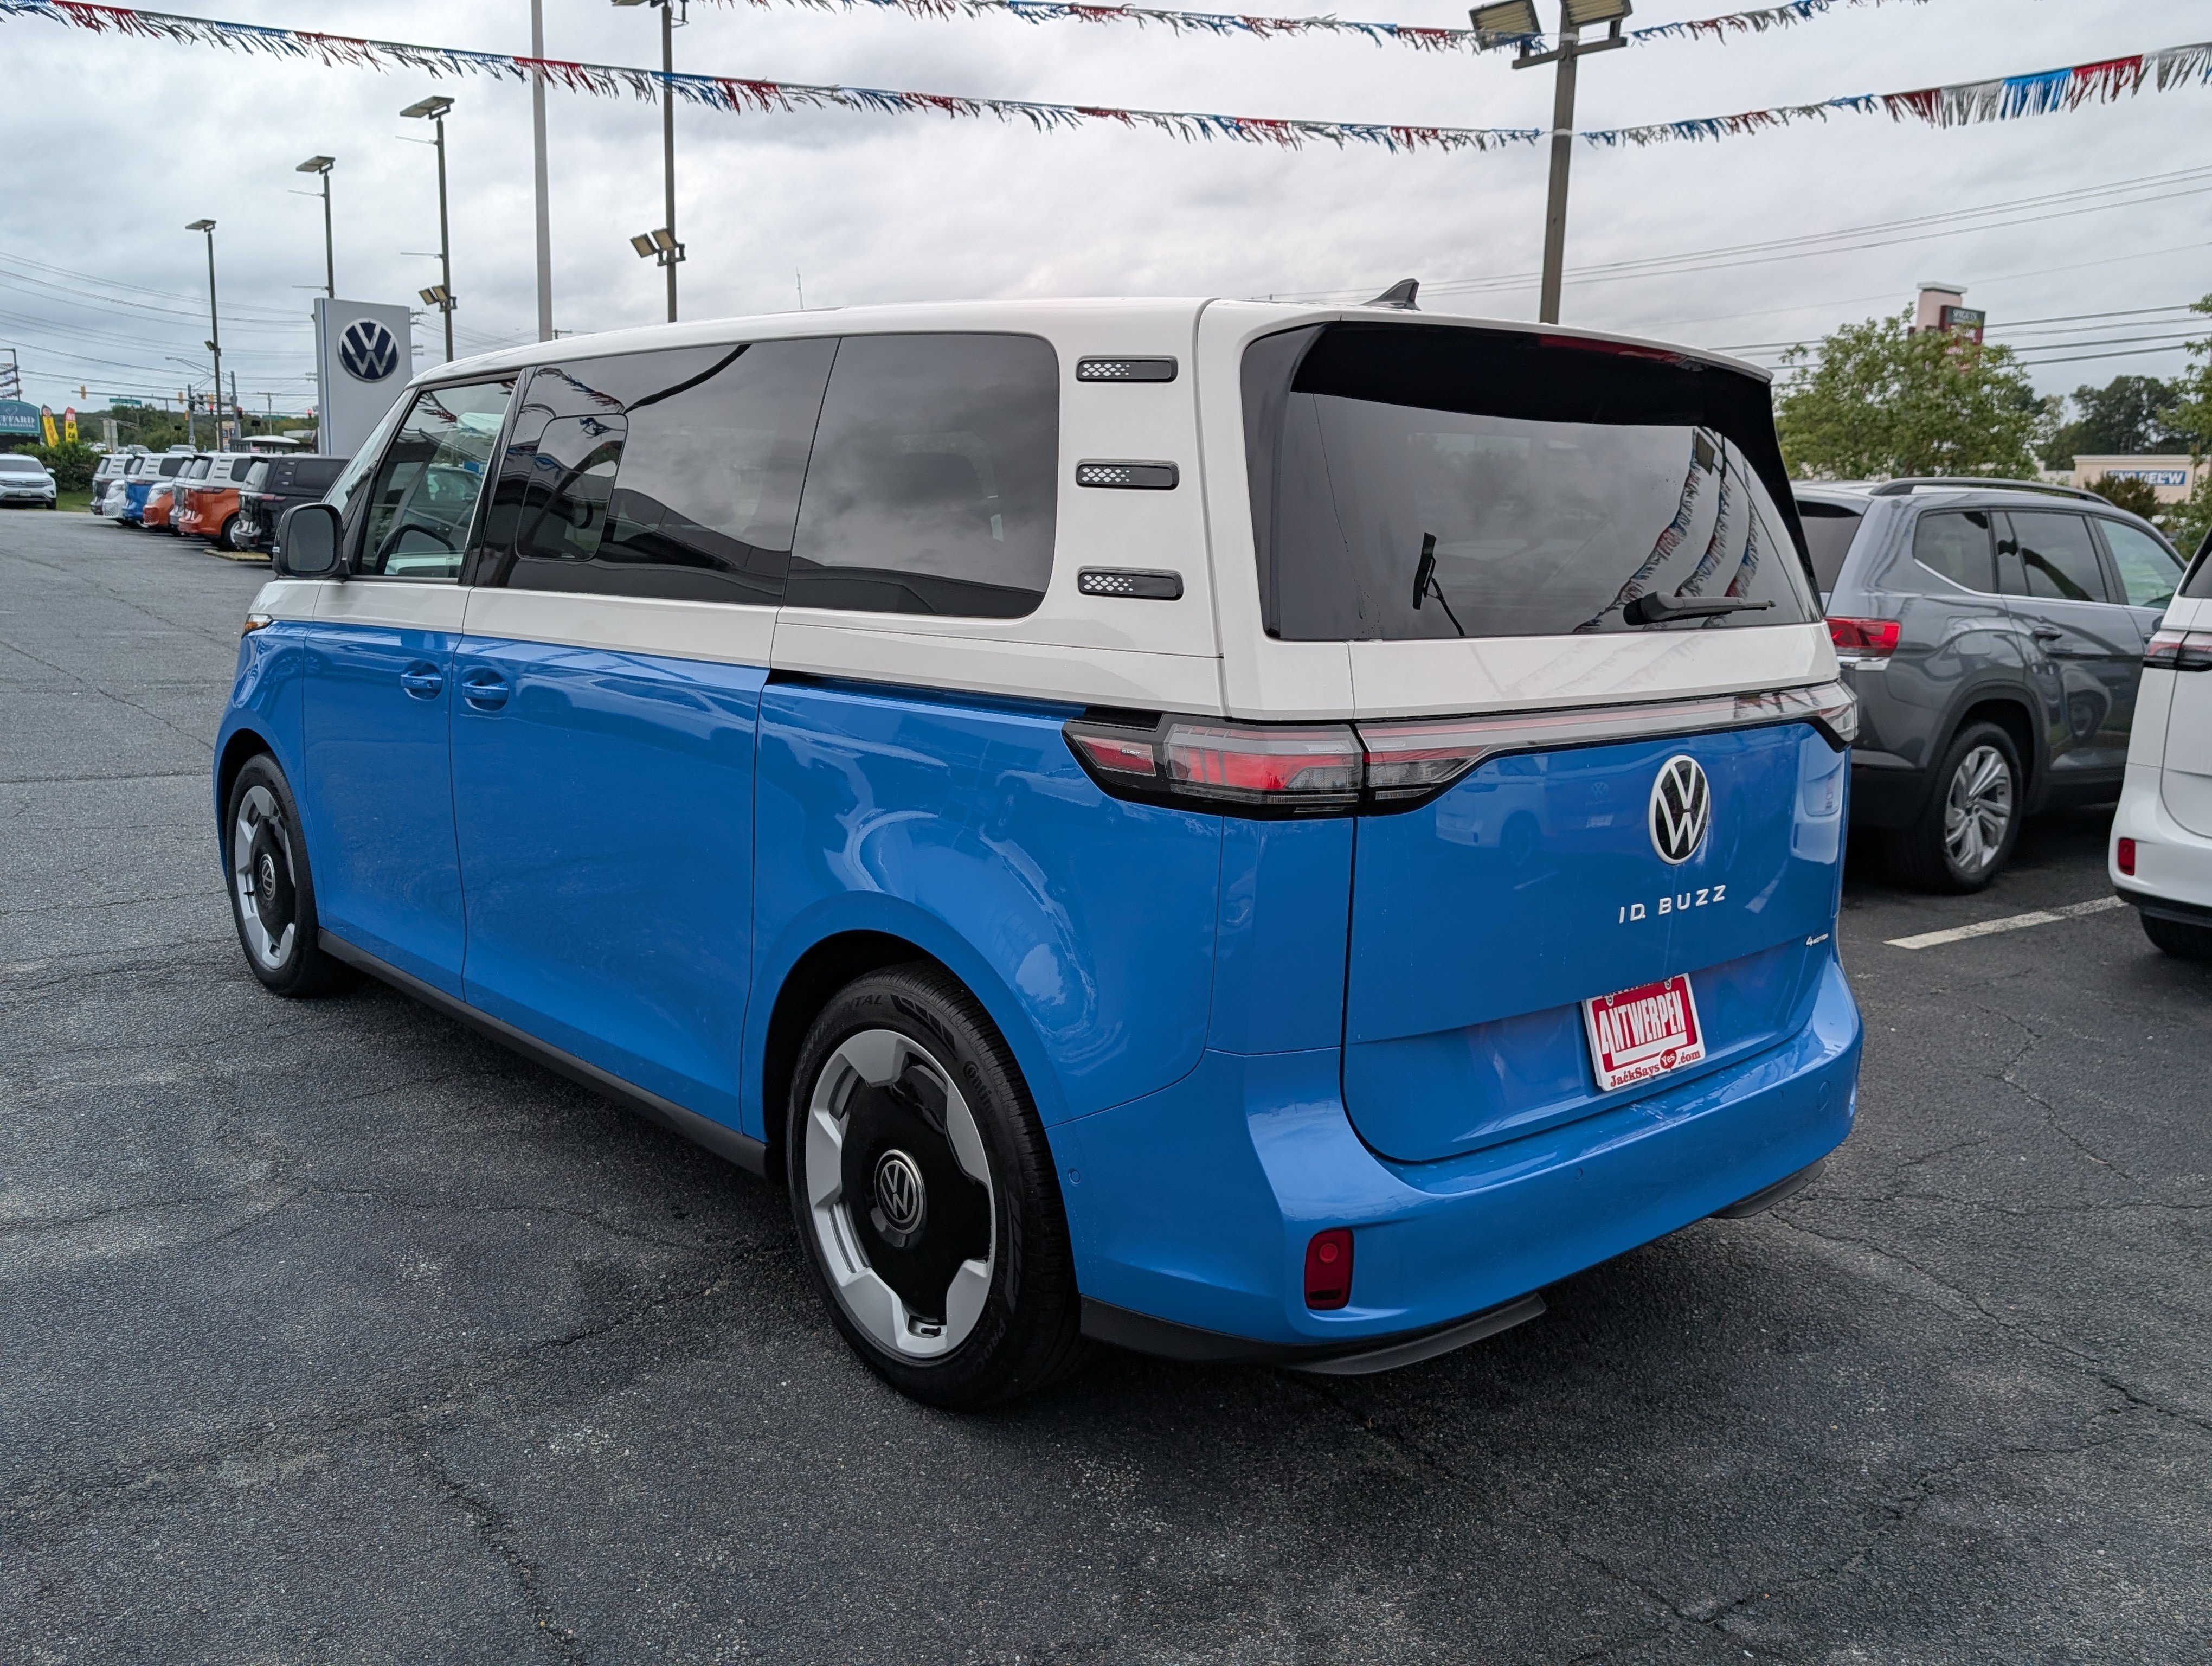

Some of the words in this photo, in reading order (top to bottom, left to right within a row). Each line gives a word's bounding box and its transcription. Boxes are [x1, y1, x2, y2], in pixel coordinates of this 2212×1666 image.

[1658, 885, 1726, 915] BUZZ
[1599, 990, 1687, 1055] ANTWERPEN
[1610, 1063, 1660, 1087] JackSays
[1661, 1053, 1675, 1066] Yes
[1678, 1050, 1701, 1065] .com
